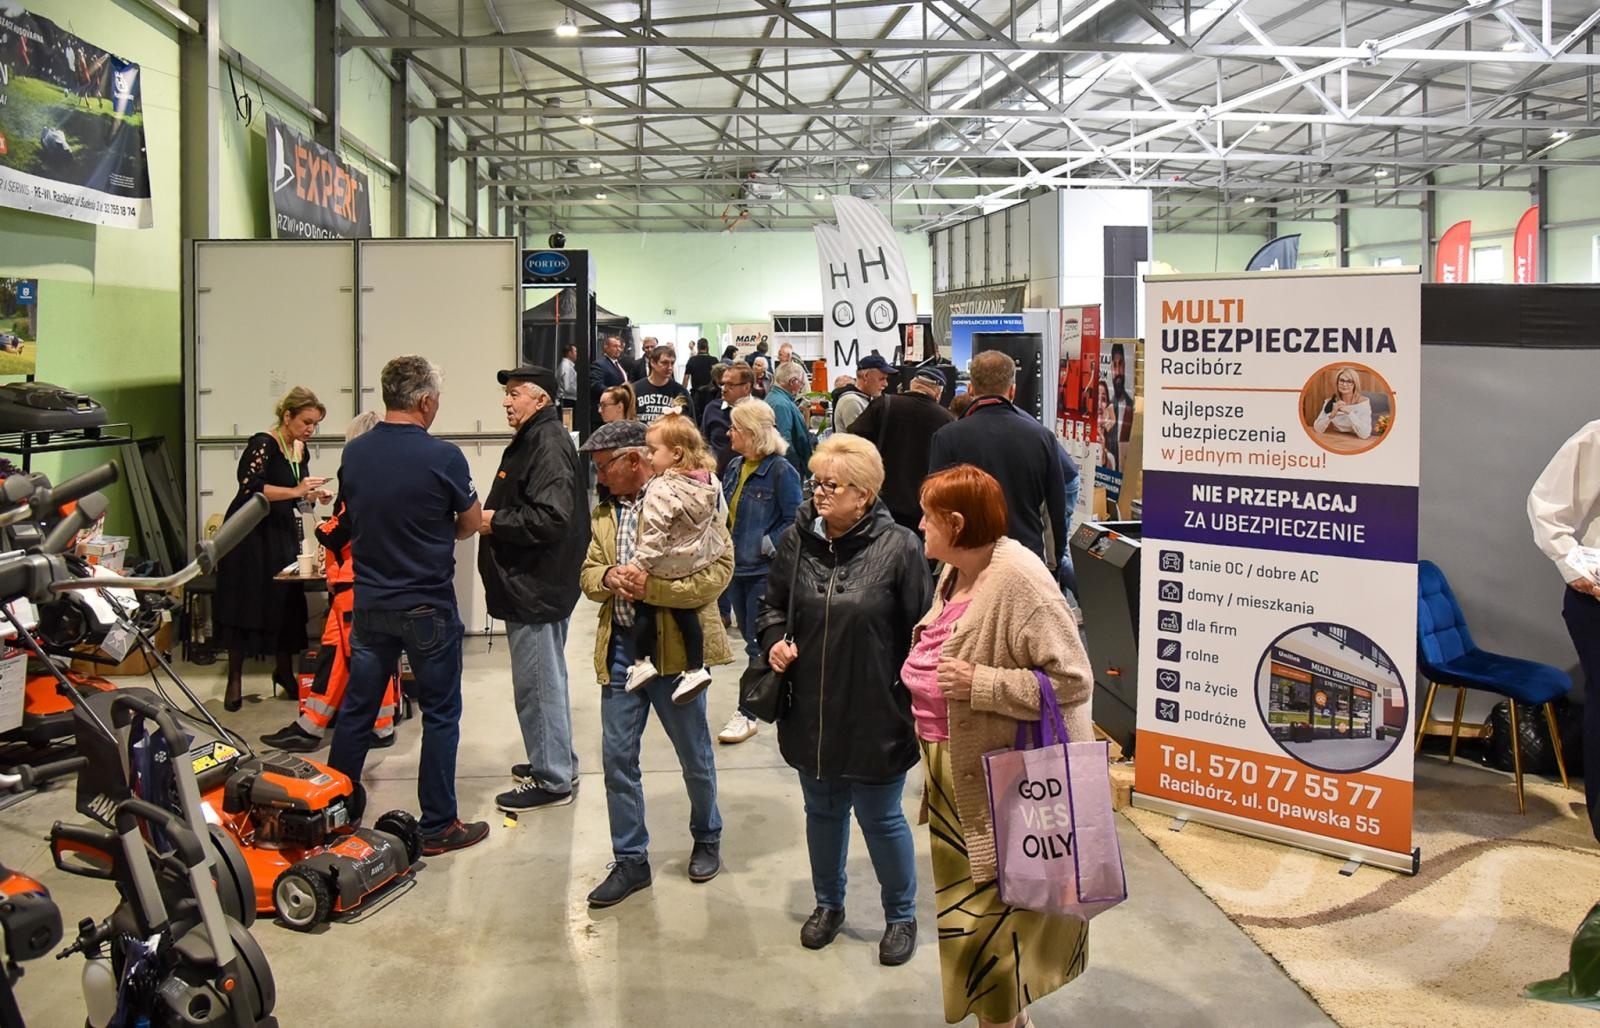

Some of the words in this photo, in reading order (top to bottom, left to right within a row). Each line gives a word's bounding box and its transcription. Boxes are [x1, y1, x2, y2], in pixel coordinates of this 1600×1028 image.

[294, 144, 358, 223] EXPERT
[528, 260, 567, 268] PORTOS
[1162, 298, 1244, 324] MULTI
[1161, 327, 1397, 354] UBEZPIECZENIA
[1161, 357, 1243, 376] Racibórz
[645, 405, 664, 413] STAT
[1161, 399, 1244, 421] Najlepsze
[1161, 422, 1286, 446] ubezpieczenia
[1161, 449, 1176, 461] w
[1177, 446, 1243, 468] jednym
[1248, 450, 1327, 471] miejscu!
[1192, 484, 1222, 504] NIE
[1226, 487, 1357, 513] PRZEPŁACAJ
[1184, 511, 1207, 530] ZA
[1210, 513, 1366, 543] UBEZPIECZENIE
[1189, 558, 1222, 574] tanie
[1225, 562, 1244, 576] OC
[1256, 564, 1297, 581] dobre
[1300, 569, 1319, 584] AC
[1187, 588, 1223, 607] domy
[1236, 594, 1315, 616] mieszkania
[1186, 618, 1207, 633] dla
[1210, 620, 1237, 637] firm
[1186, 648, 1219, 664] rolne
[1311, 663, 1332, 676] MULTI
[1185, 681, 1201, 692] na
[1204, 680, 1238, 698] życie
[1184, 707, 1246, 729] podróżne
[1160, 744, 1202, 774] Tel.
[1209, 753, 1257, 785] 570
[1264, 764, 1297, 793] 77
[1304, 772, 1338, 803] 55
[1346, 781, 1382, 810] 77
[1159, 773, 1237, 806] Racibórz,
[1242, 791, 1262, 810] ul.
[1267, 798, 1350, 830] Opawska
[1355, 816, 1380, 836] 55
